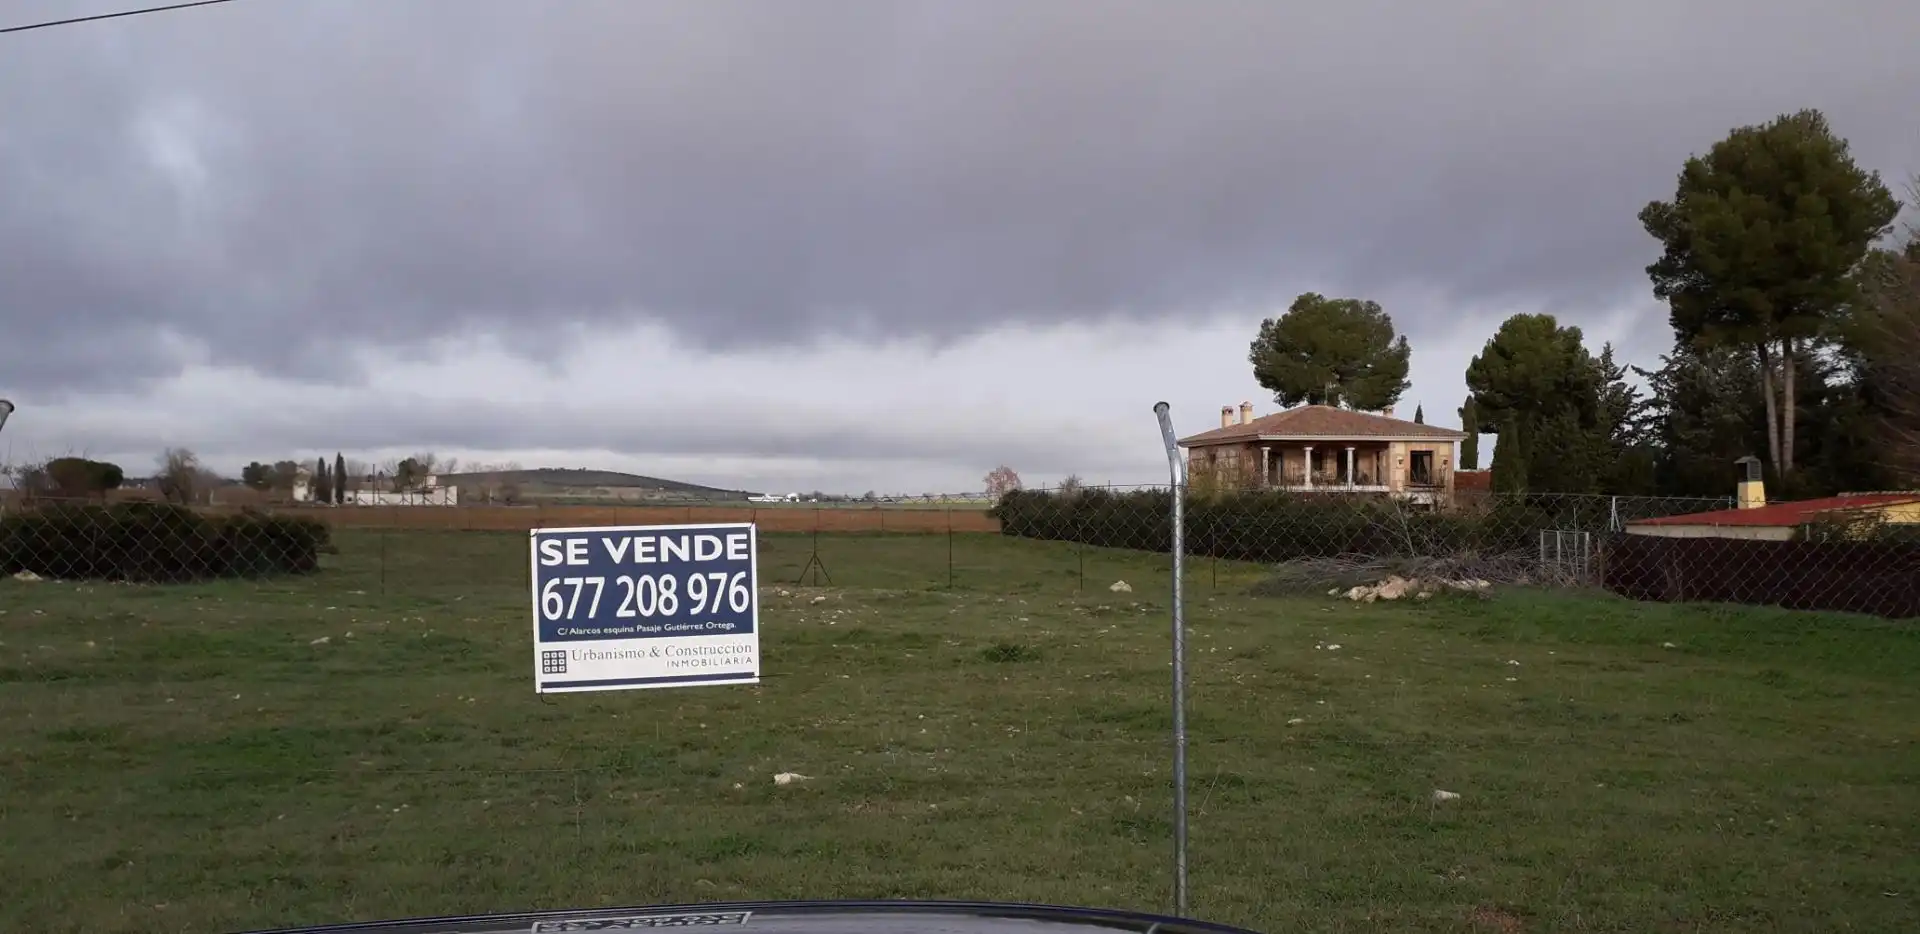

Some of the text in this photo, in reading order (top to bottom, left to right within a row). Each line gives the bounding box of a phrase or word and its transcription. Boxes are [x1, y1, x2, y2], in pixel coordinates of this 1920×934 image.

[540, 533, 749, 566] SE VENDE
[542, 571, 749, 621] 677 208 976
[557, 621, 737, 636] C/ Alarcos esquina Pasaje Gutiérrez Ortega.
[571, 641, 752, 661] Urbanismo & Construcción
[666, 656, 753, 668] INMOBILIARIA
